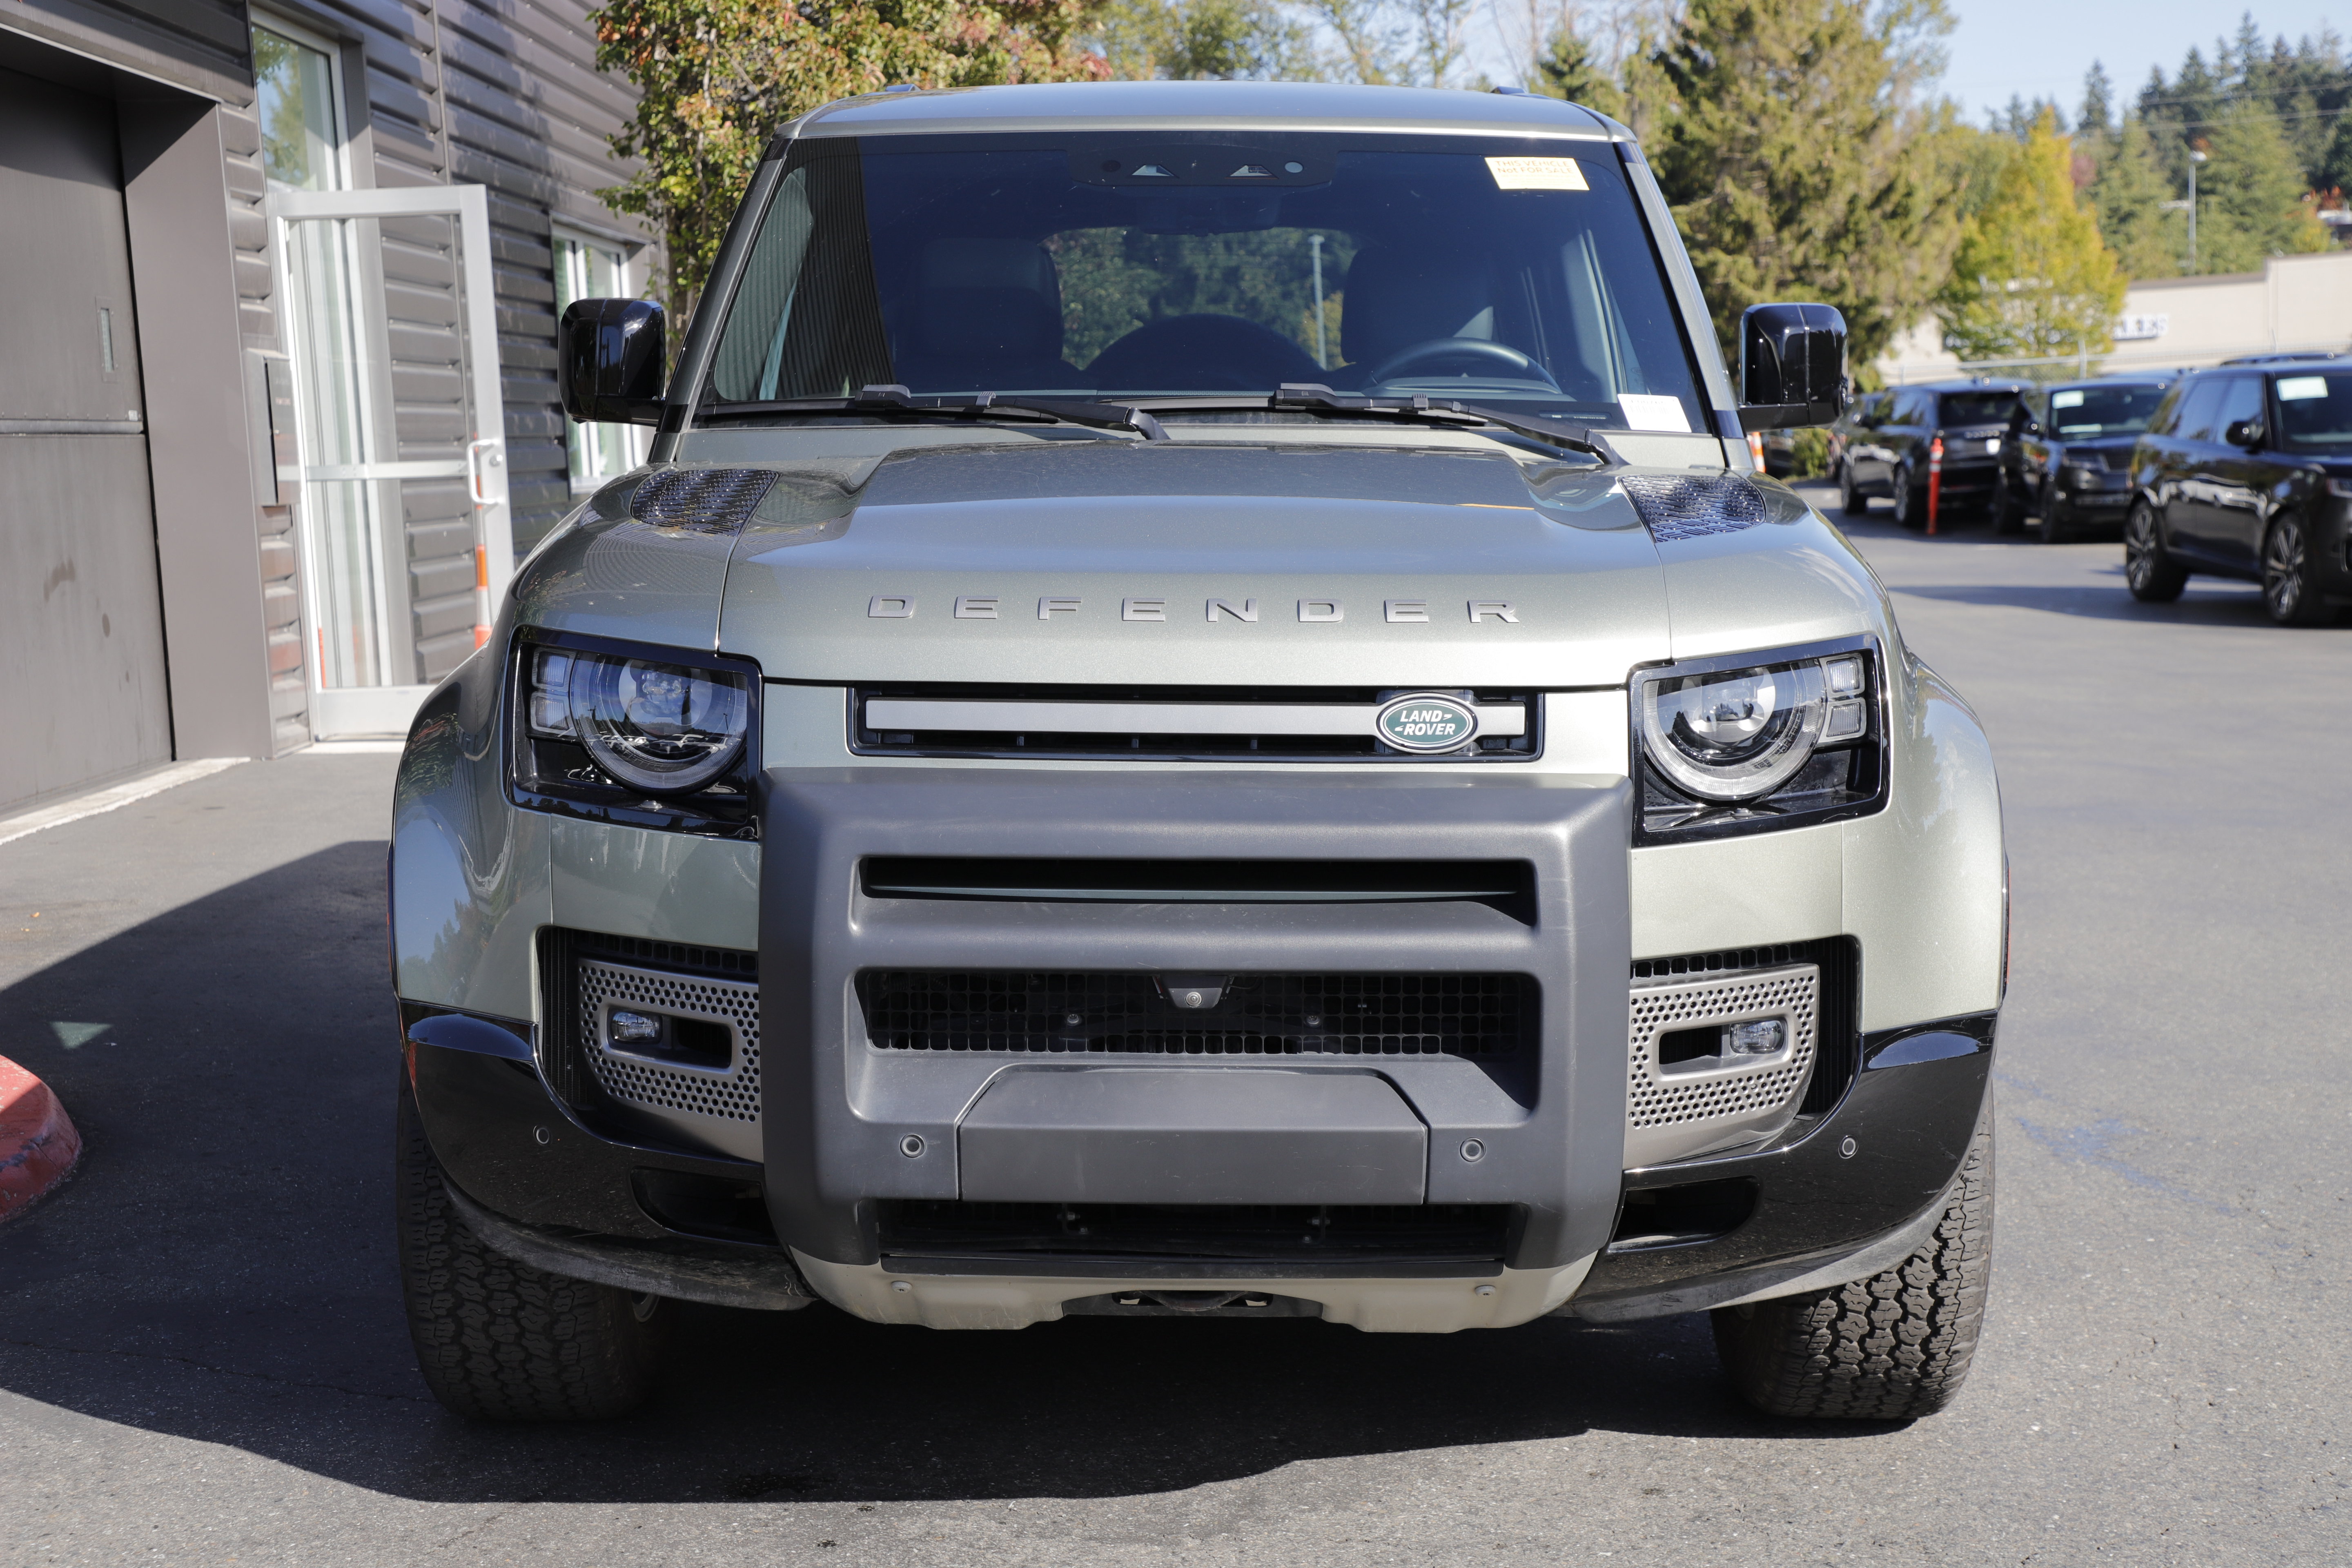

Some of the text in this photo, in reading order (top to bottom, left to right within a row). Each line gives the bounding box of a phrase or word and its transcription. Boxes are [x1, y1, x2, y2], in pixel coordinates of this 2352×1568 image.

[867, 595, 1520, 624] DEFENDER
[1400, 710, 1442, 722] LAND
[1404, 723, 1455, 735] ROVER
